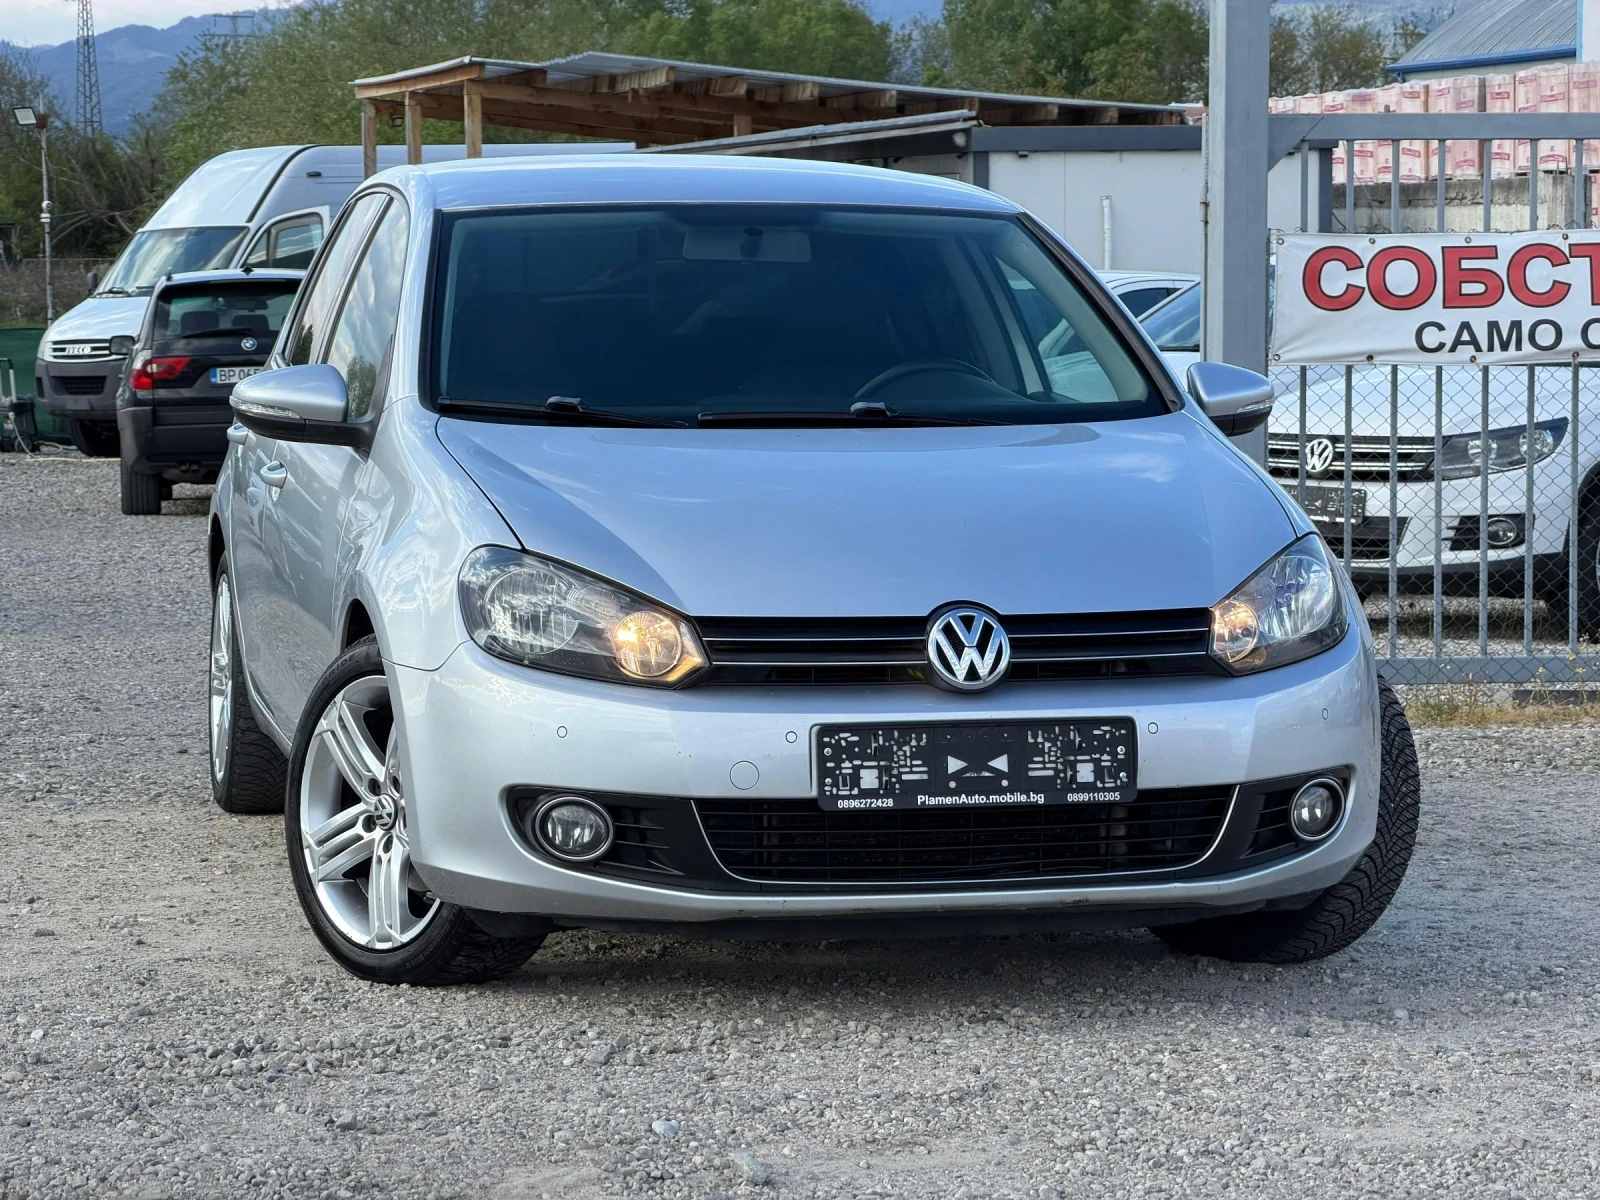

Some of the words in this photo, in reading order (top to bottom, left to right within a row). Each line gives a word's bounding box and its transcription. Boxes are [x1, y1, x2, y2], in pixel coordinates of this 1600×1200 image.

[1414, 318, 1563, 353] САМО
[930, 609, 1008, 688] VW
[837, 798, 894, 808] 0896272428
[917, 792, 1045, 805] PlamenAuto.mobile.bg
[1067, 792, 1120, 802] 0899110305
